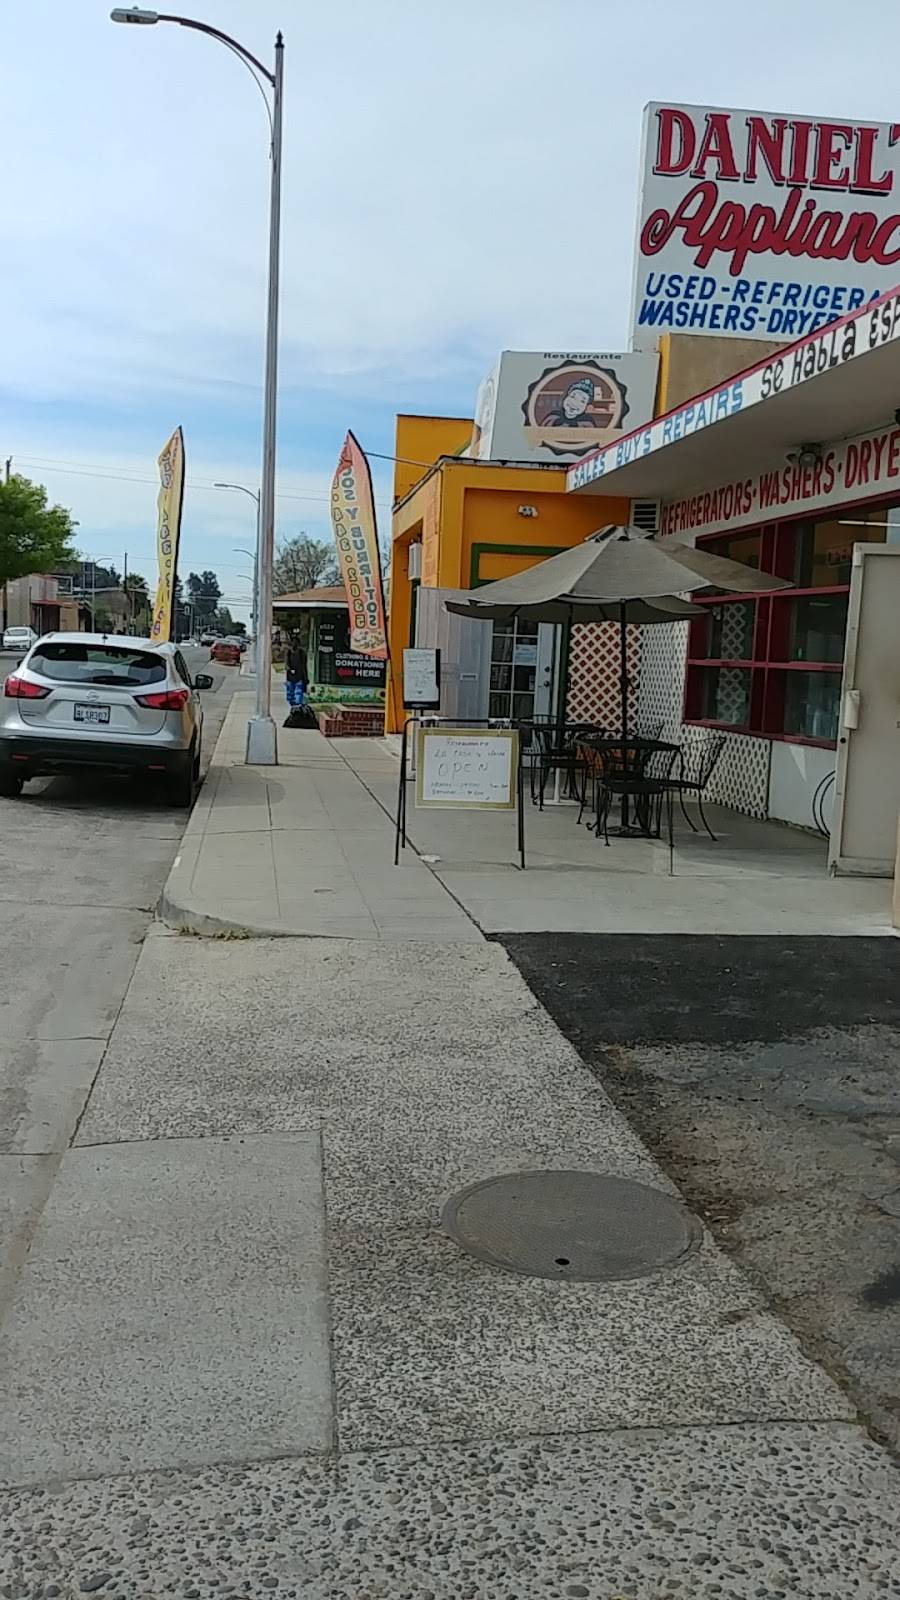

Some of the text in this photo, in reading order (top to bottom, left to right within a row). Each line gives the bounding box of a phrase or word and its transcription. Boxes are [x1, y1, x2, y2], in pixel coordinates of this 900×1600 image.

[640, 181, 900, 277] Applianc
[543, 352, 622, 360] Restaurante
[574, 452, 606, 488] SALES
[616, 430, 651, 466] BUYS
[662, 381, 743, 444] REPAIRS
[661, 479, 753, 537] REFRIGERATORS
[760, 452, 834, 509] WASHERS
[335, 660, 385, 669] DONATIONS
[355, 669, 380, 677] HERE
[438, 762, 489, 780] OPEN
